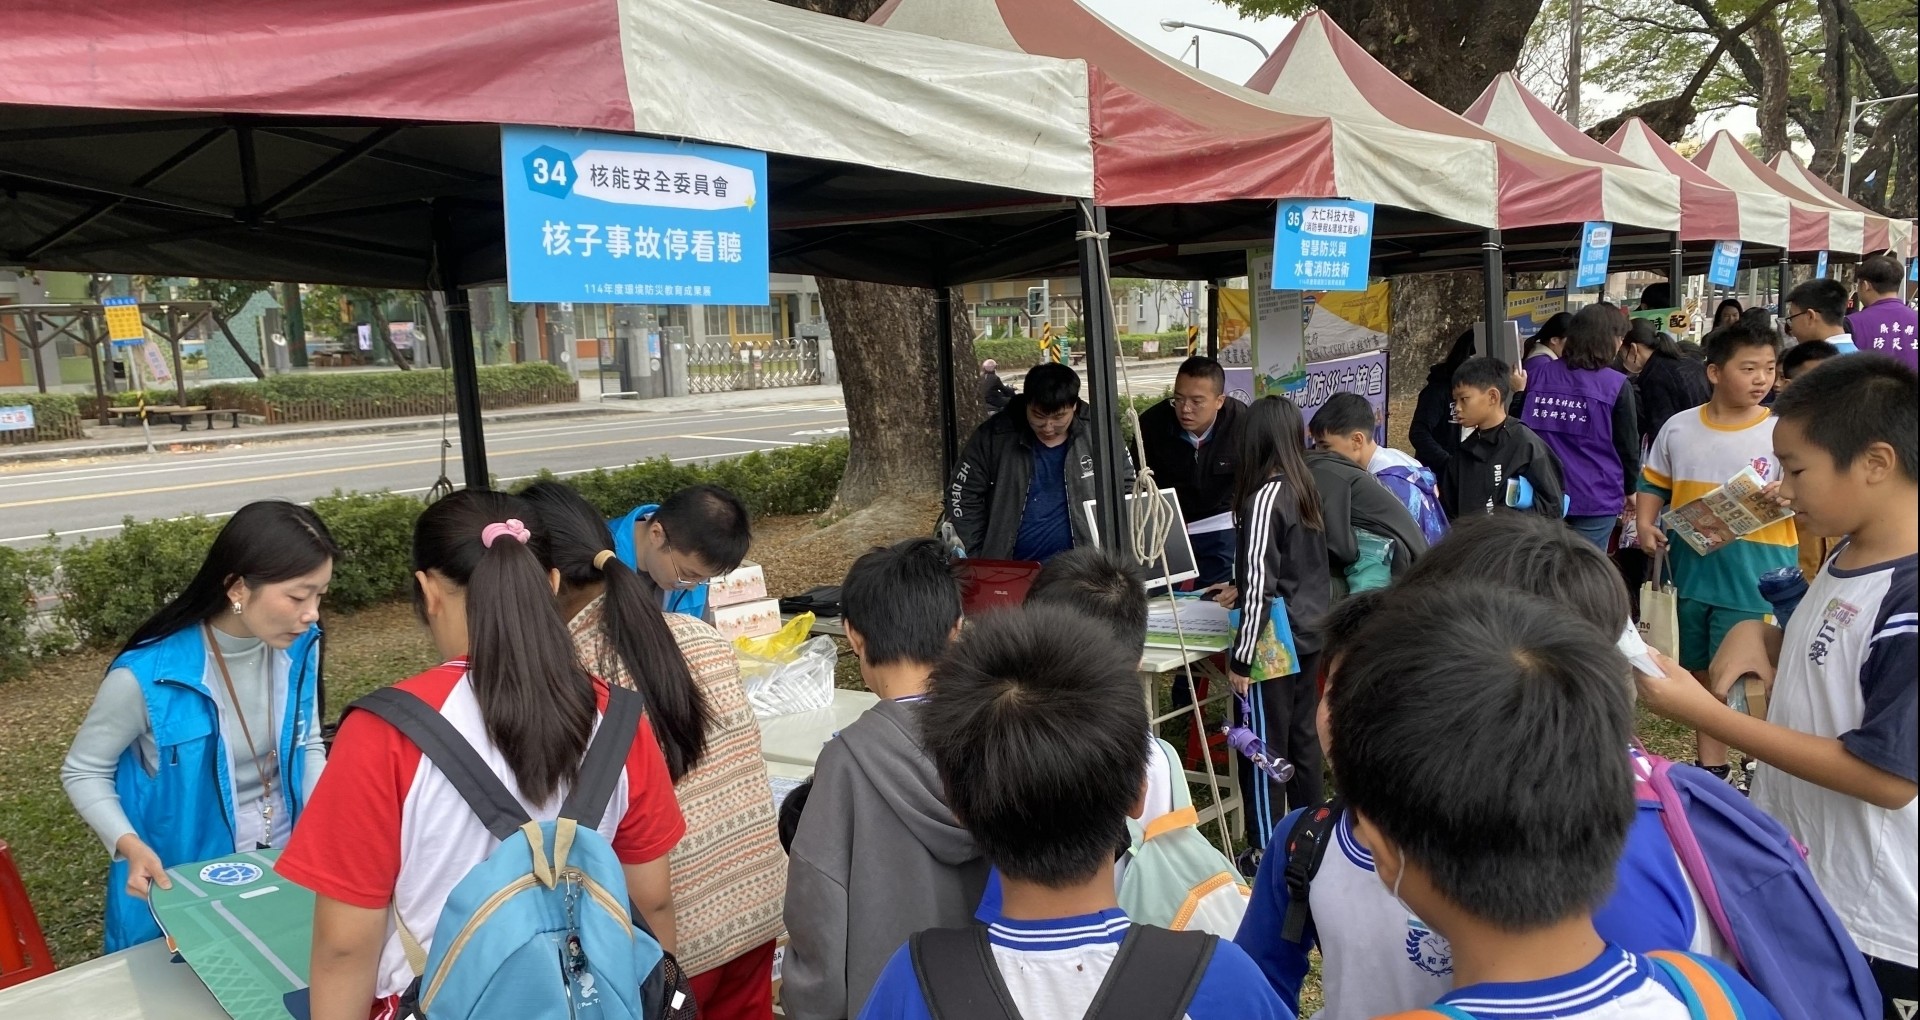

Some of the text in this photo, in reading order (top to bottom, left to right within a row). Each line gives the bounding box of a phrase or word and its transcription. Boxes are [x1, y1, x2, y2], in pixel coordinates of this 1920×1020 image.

[533, 157, 567, 186] 34
[589, 163, 729, 198] 核能安全委員會
[1287, 211, 1300, 227] 35
[1311, 208, 1356, 224] 大仁科技大學
[541, 219, 742, 263] 核子事故停看聽
[1301, 239, 1347, 258] 智慧防災與
[1293, 260, 1350, 278] 水電消防技術
[584, 283, 711, 297] 114年度環境防災教育成果展
[1880, 321, 1915, 336] 屏東縣
[1873, 337, 1918, 350] 防災士
[1532, 408, 1587, 422] 災防研究中心
[951, 461, 971, 518] HE DENG
[1809, 619, 1836, 665] 仁愛
